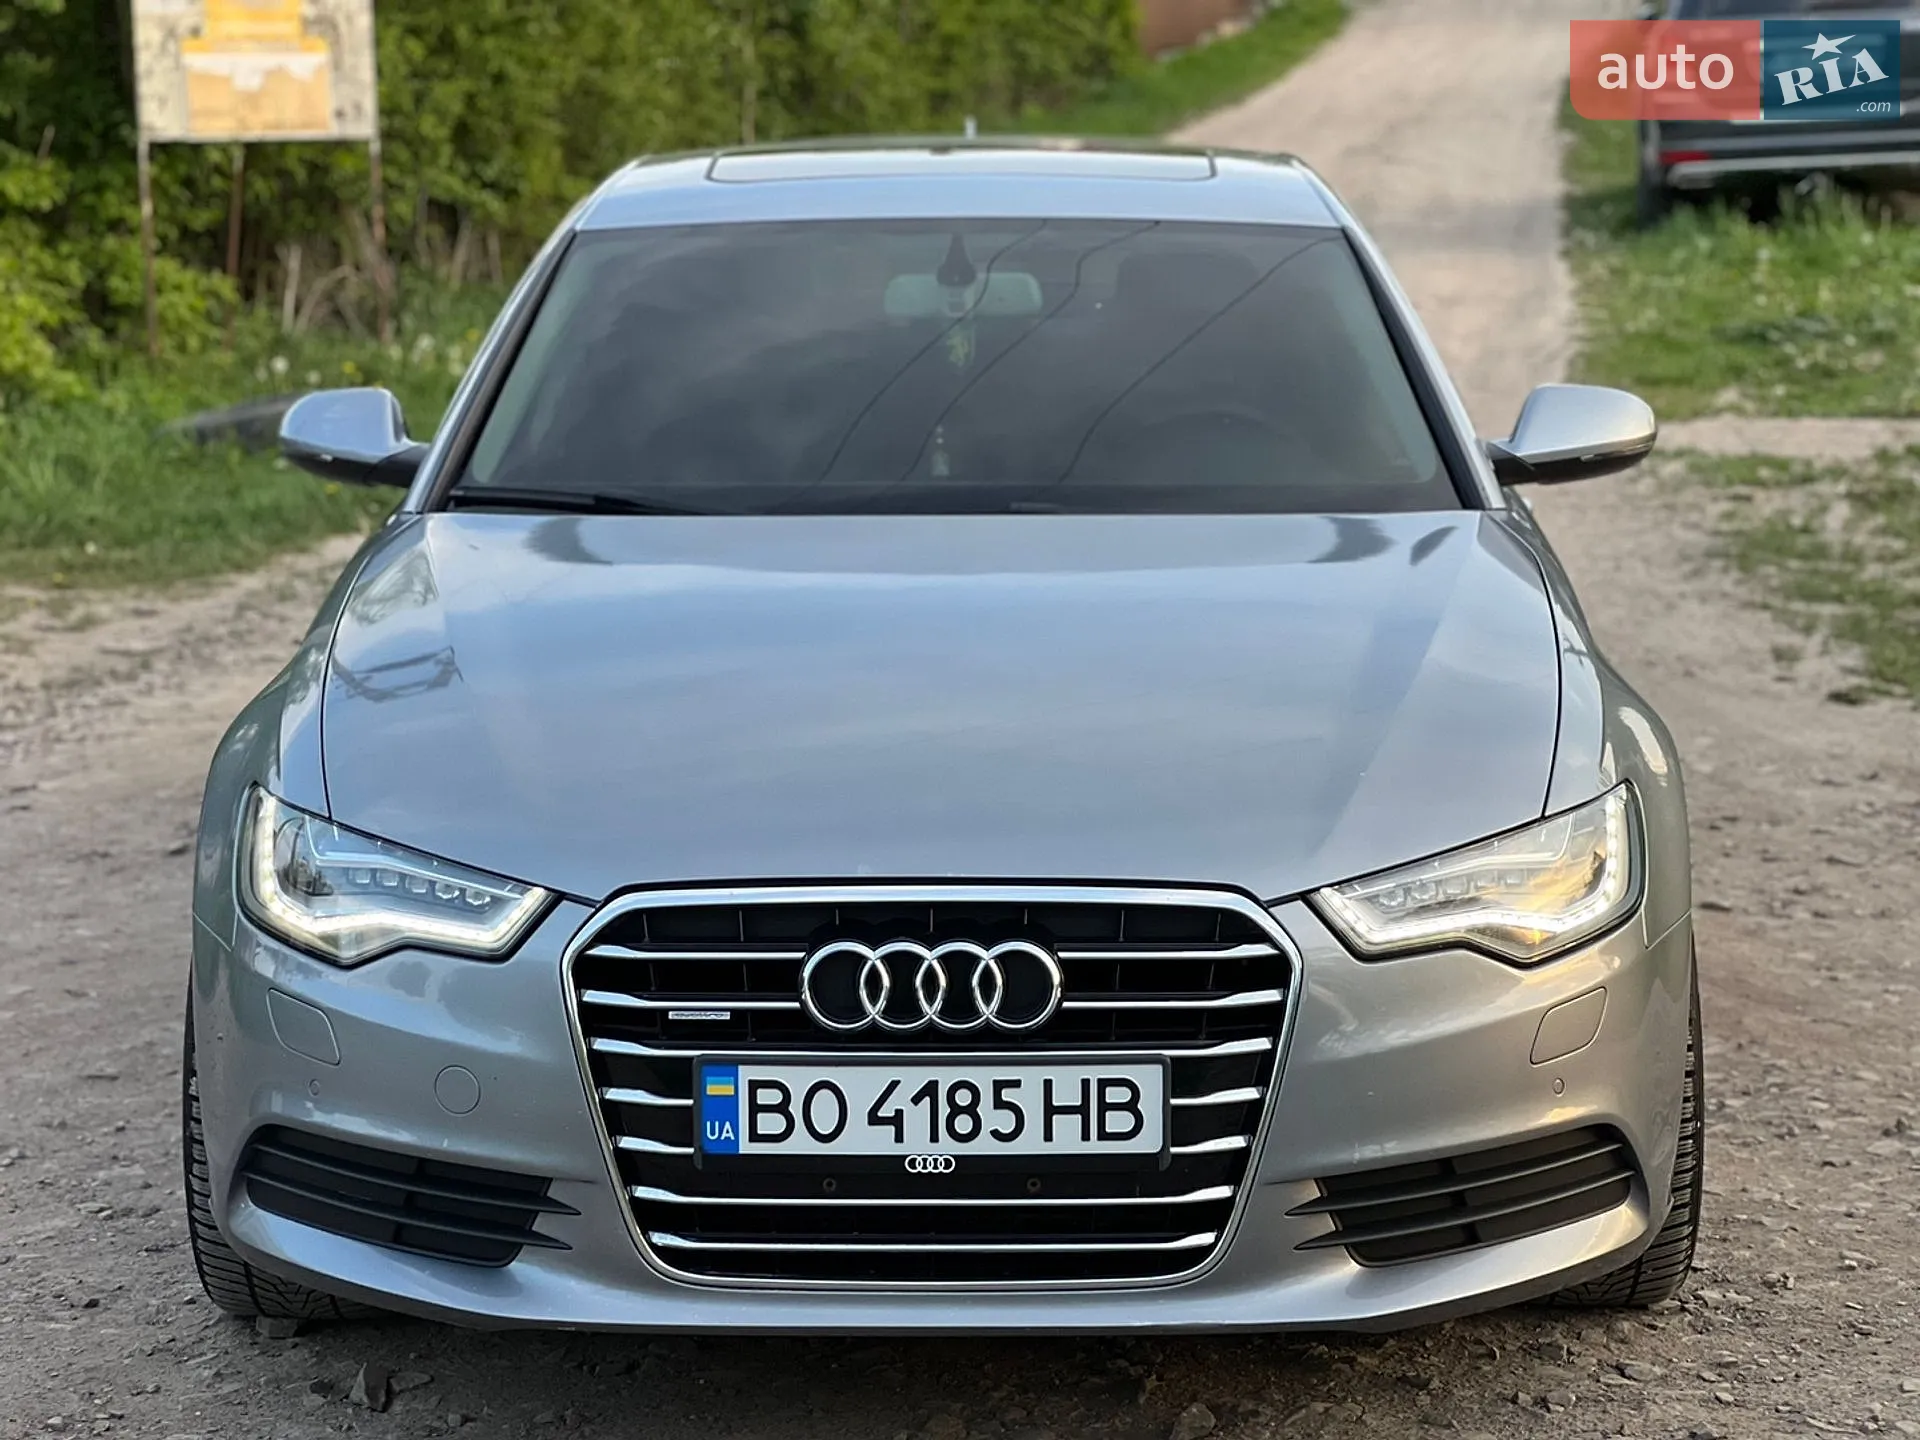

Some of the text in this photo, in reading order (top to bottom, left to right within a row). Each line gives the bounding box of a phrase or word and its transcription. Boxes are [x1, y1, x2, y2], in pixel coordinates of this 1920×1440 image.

[706, 1078, 1144, 1144] UA BO 4185 HB
